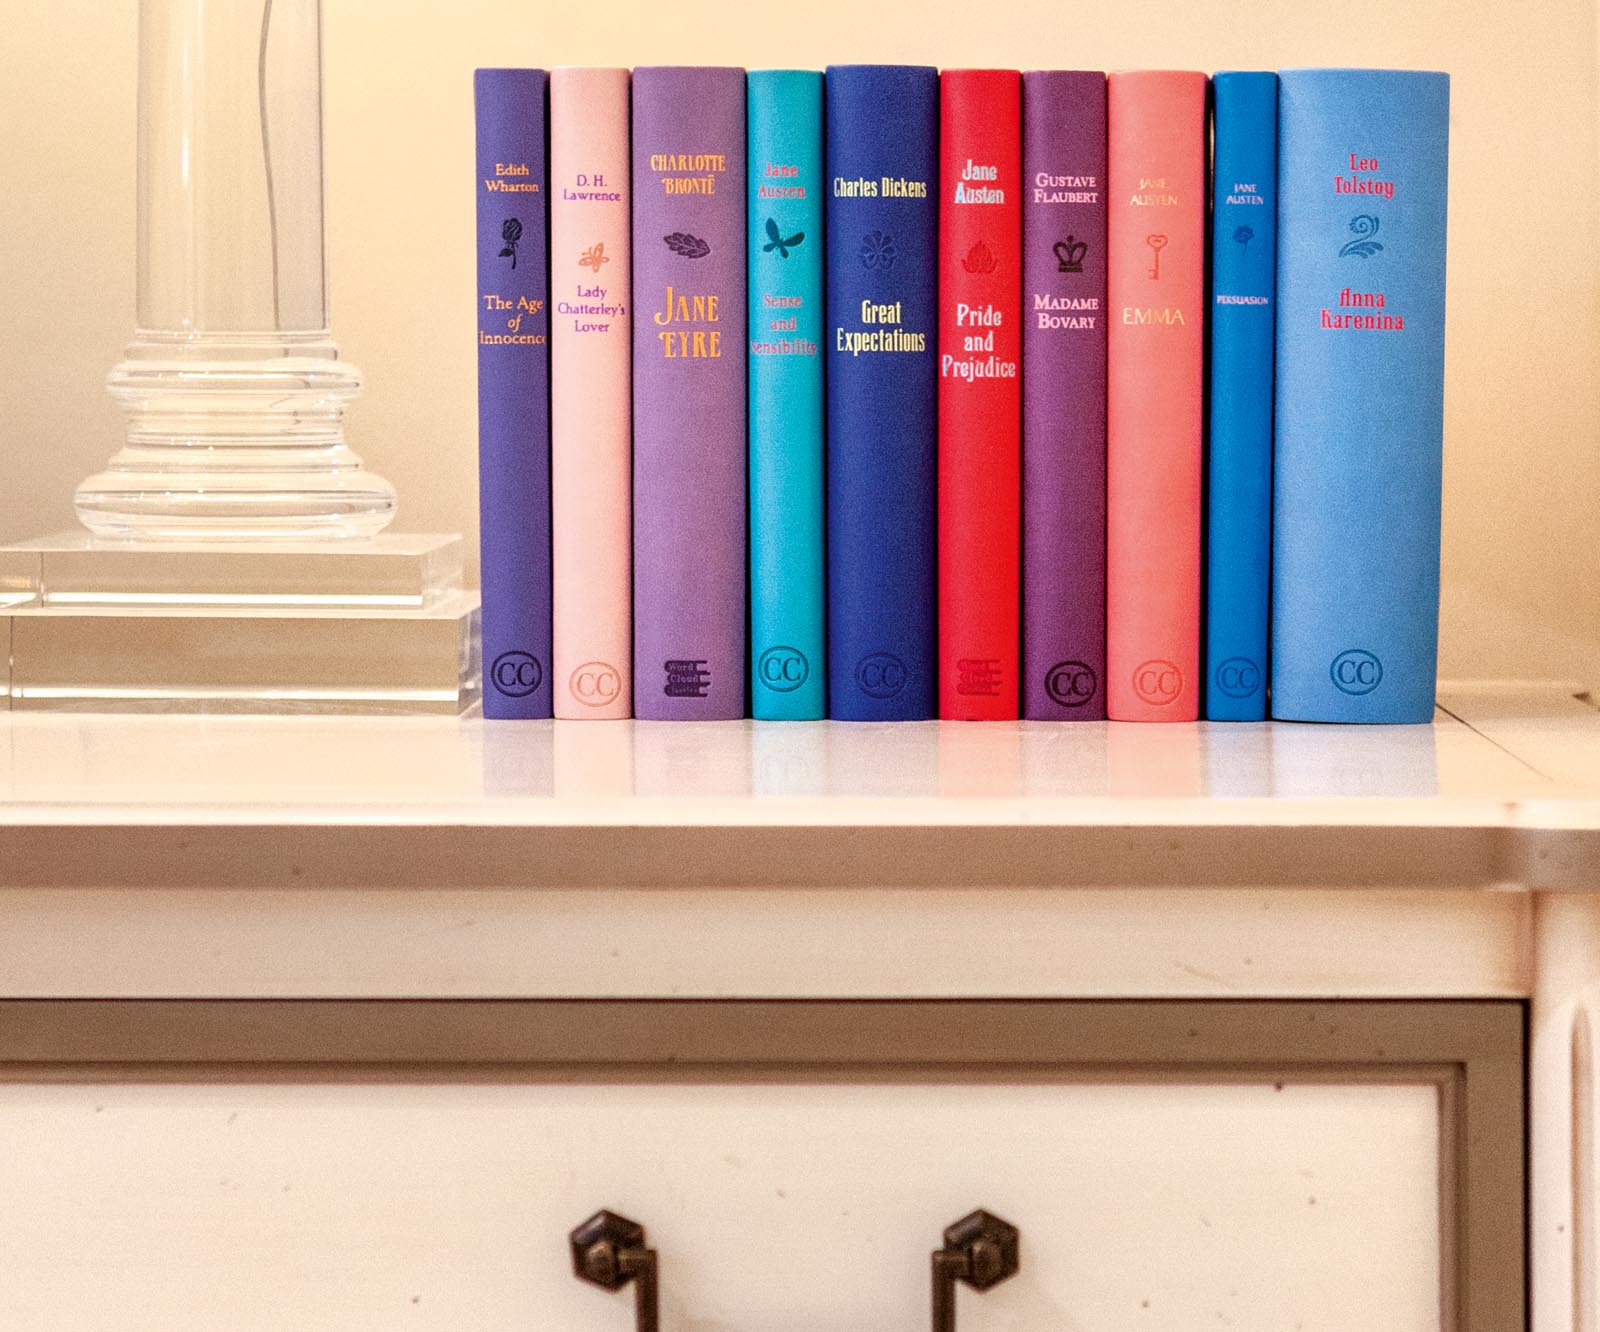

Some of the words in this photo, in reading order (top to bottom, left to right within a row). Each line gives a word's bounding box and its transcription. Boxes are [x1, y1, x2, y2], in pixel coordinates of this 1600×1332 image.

[495, 163, 529, 177] Edith
[651, 154, 726, 172] CHARLOTTE
[765, 163, 799, 178] Jane
[962, 159, 997, 181] Jane
[1350, 153, 1378, 171] Leo
[485, 180, 539, 193] Wharton
[576, 175, 589, 187] D.
[594, 175, 608, 187] H.
[834, 177, 877, 198] Charles
[881, 177, 927, 198] Dickens
[1035, 173, 1096, 188] GUSTAVE
[1334, 176, 1394, 199] Tolstoy
[563, 189, 621, 201] Lawrence
[759, 185, 806, 198] Austen
[954, 182, 1004, 204] Austen
[1034, 189, 1098, 204] FLAUBERT
[1226, 195, 1264, 205] AUSTEN
[577, 285, 607, 299] Lady
[1339, 288, 1385, 308] Anna
[485, 295, 513, 310] The
[517, 296, 544, 313] Age
[557, 303, 625, 317] Chatterley's
[654, 287, 719, 325] JANE
[764, 295, 802, 309] Sense
[1034, 294, 1099, 310] MADAME
[861, 300, 901, 324] Great
[957, 303, 1002, 326] Pride
[1038, 313, 1096, 329] BOVARY
[1123, 307, 1185, 326] EMMA
[1320, 310, 1404, 331] Karenina
[507, 315, 522, 333] of
[575, 321, 609, 333] Lover
[770, 316, 796, 331] and
[658, 331, 721, 358] EYRE
[836, 328, 925, 356] Expectations
[964, 331, 993, 352] and
[942, 354, 1016, 382] Prejudice
